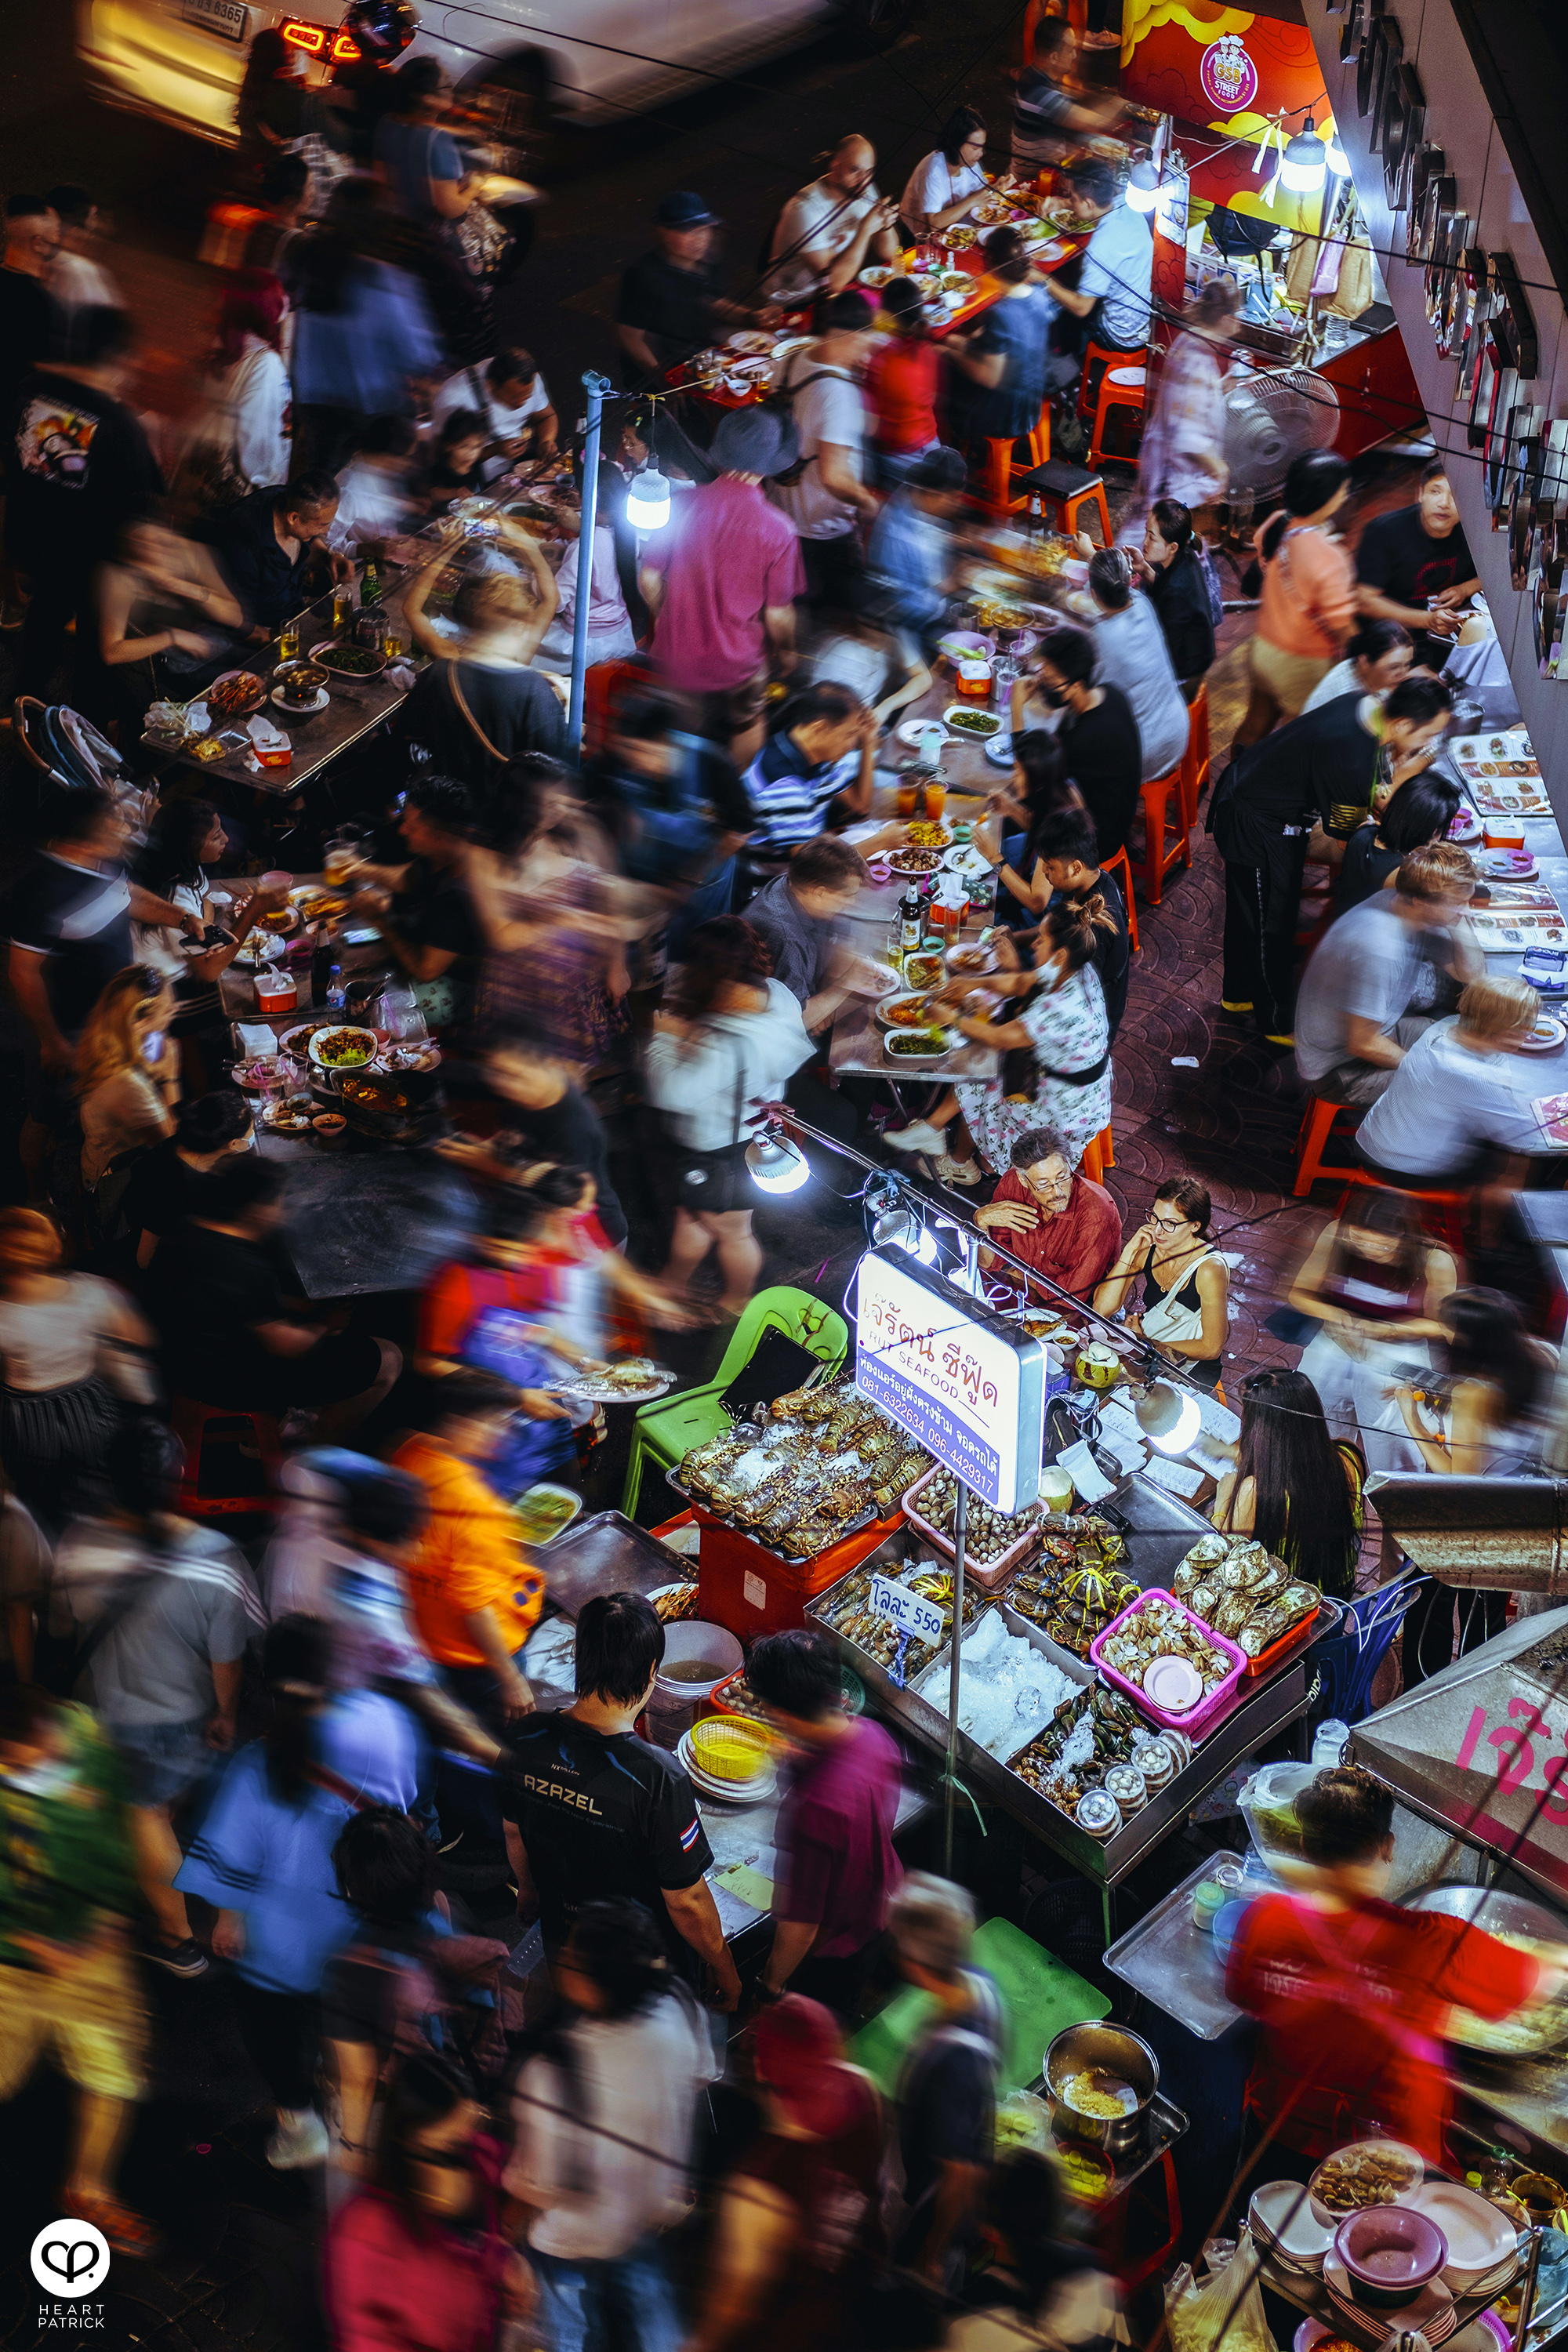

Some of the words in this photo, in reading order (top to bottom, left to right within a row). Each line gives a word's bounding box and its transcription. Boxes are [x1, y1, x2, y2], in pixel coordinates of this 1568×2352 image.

[213, 1, 242, 24] 6365
[1214, 62, 1241, 84] GSB
[1214, 81, 1240, 95] STREET
[1218, 89, 1235, 100] FOOD
[869, 1331, 894, 1352] RUT
[898, 1351, 958, 1399] SEAFOOD
[862, 1375, 924, 1433] 081-6322634
[928, 1428, 994, 1494] 096-4429317
[956, 1429, 998, 1476] จอดรถได้
[872, 1578, 909, 1618] โลละ
[913, 1607, 940, 1635] 550
[524, 1774, 603, 1816] AZAZEL
[586, 1817, 625, 1833] Experience
